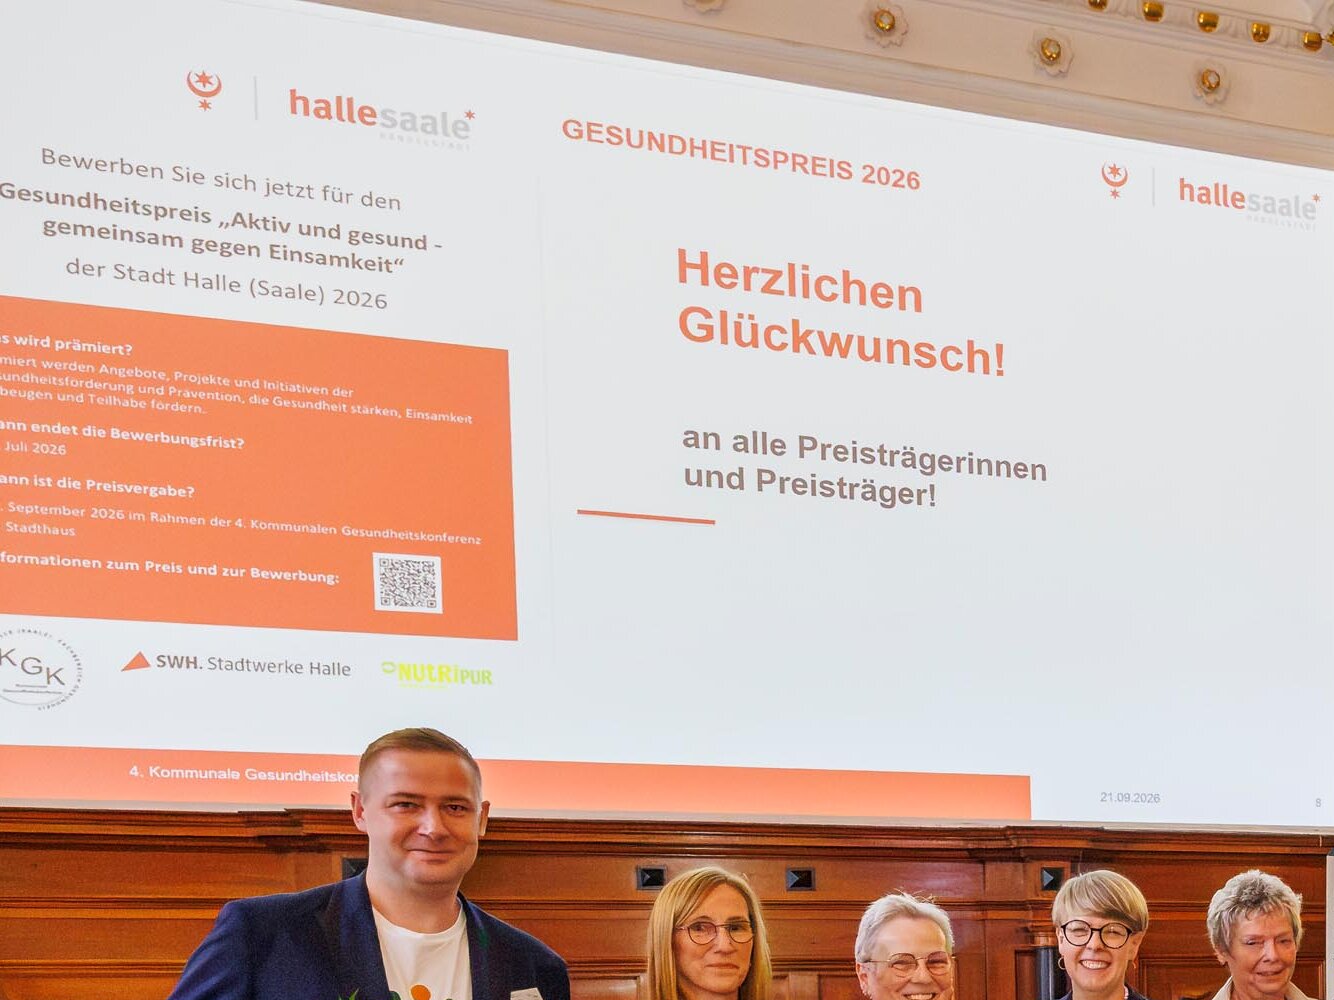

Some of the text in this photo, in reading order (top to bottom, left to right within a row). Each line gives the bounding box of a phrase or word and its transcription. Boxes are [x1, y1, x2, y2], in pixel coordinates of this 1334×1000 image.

[289, 88, 471, 140] hallesaale
[562, 118, 921, 191] GESUNDHEITSPREIS 2026
[42, 148, 401, 210] Bewerben Sie sich jetzt für den
[1179, 177, 1317, 220] hallesaale
[0, 183, 427, 250] Gesundheitspreis „Aktiv und gesund
[43, 220, 404, 273] gemeinsam gegen Einsamkeit“
[66, 258, 388, 310] der Stadt Halle (Saale) 2026
[677, 247, 923, 313] Herzlichen
[14, 334, 50, 348] wird
[55, 338, 133, 355] prämiert?
[678, 305, 1005, 377] Glückwunsch!
[41, 360, 354, 398] werden Angebote, Projekte und Initiativen der
[57, 393, 147, 408] und Teilhabe
[138, 386, 164, 395] und
[272, 396, 347, 413] Gesundheit
[405, 408, 473, 424] Einsamkeit
[4, 440, 67, 455] Juli 2026
[31, 422, 244, 449] endet die Bewerbungsfrist?
[682, 429, 1048, 482] an alle Preisträgerinnen
[33, 474, 195, 498] ist die Preisvergabe?
[684, 466, 937, 509] und Preisträger!
[6, 521, 76, 536] Stadthaus
[8, 501, 84, 517] September
[90, 507, 125, 520] 2026
[129, 510, 145, 521] im
[150, 512, 205, 526] Rahmen
[210, 516, 232, 527] der
[250, 519, 337, 535] Kommunalen
[341, 526, 482, 545] Gesundheitskonferenz
[106, 560, 340, 585] zum Preis und zur Bewerbung:
[156, 655, 351, 676] SWH. Stadtwerke Halle
[128, 766, 144, 778] 4.
[149, 766, 240, 780] Kommunale
[1100, 791, 1160, 804] 21.09.2026
